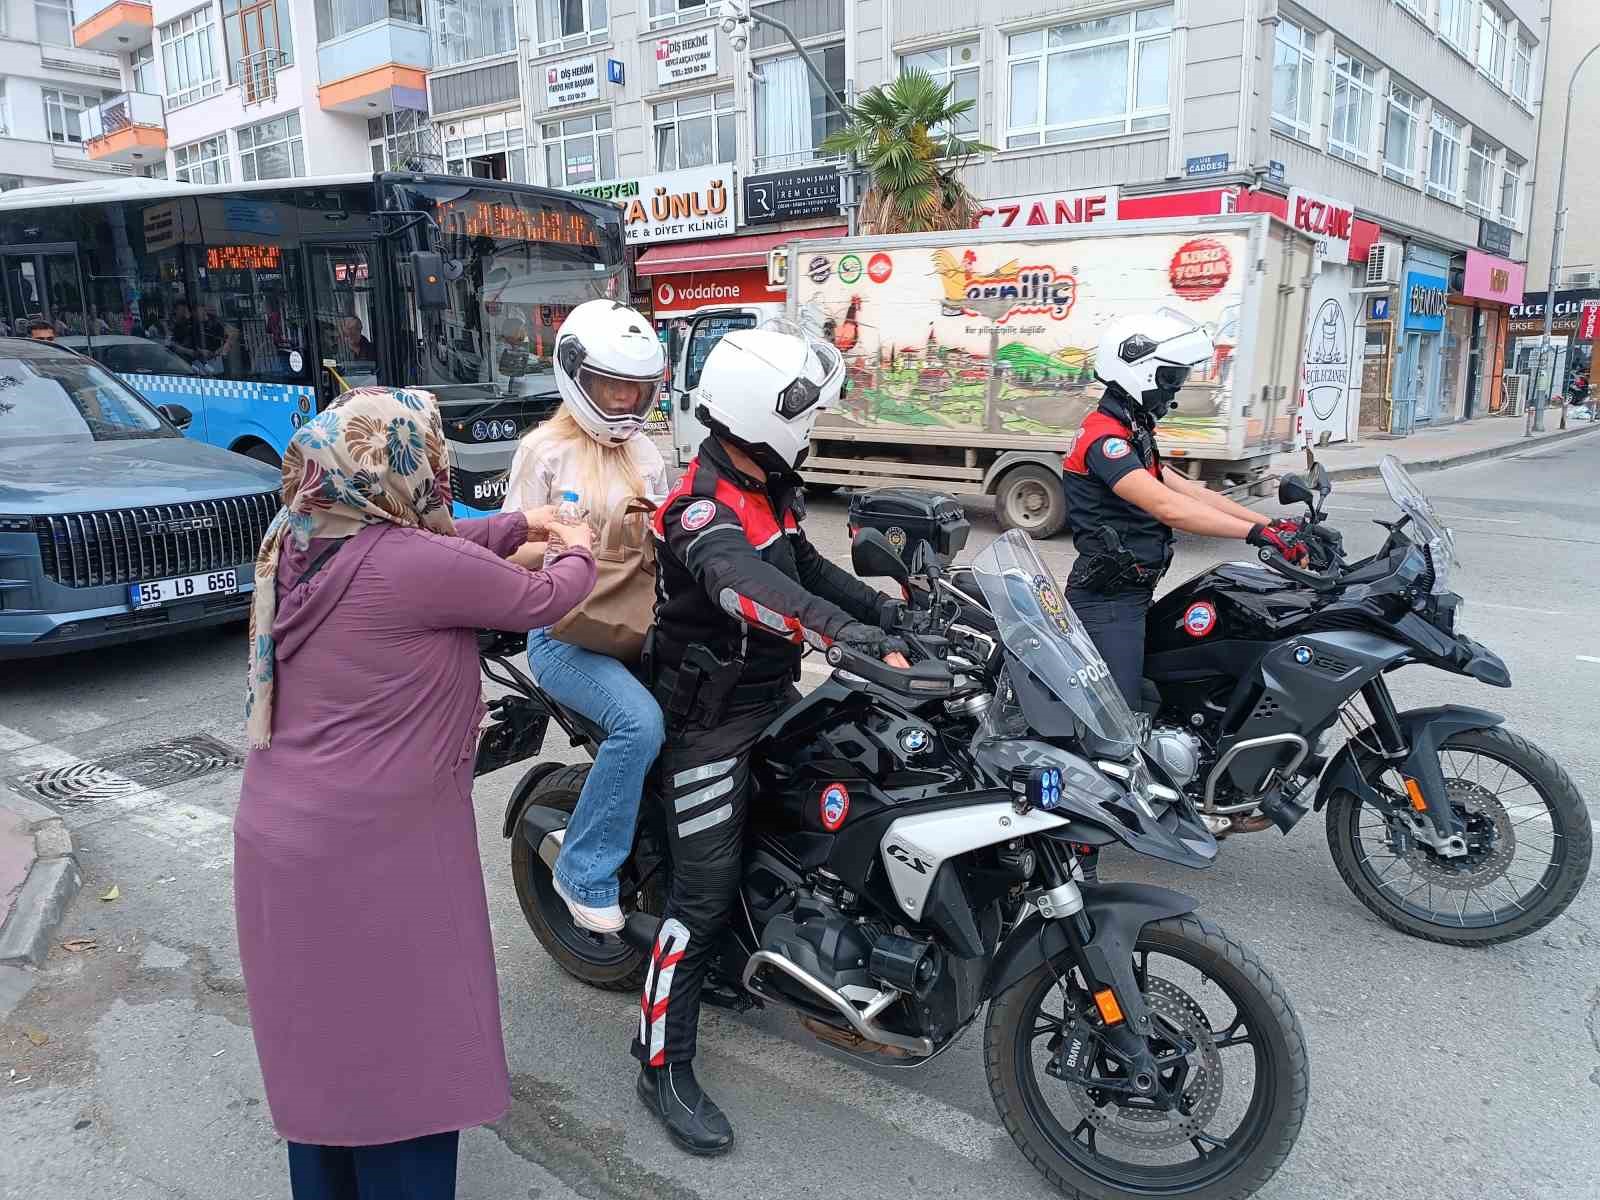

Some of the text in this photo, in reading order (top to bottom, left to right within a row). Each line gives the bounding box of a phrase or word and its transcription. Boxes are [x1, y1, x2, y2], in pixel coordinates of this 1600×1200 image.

[669, 33, 708, 54] DİŞ HEKİMİ
[560, 63, 594, 80] DİŞ HEKİMİ
[652, 179, 728, 221] ÜNLÜ
[806, 183, 836, 198] ÇELİK
[643, 229, 651, 237] &
[655, 223, 683, 236] DİYET
[688, 217, 729, 233] KLİNİĞİ
[1295, 195, 1352, 240] ECZANE
[678, 282, 740, 300] vodafone
[141, 584, 161, 602] 55
[175, 578, 194, 597] LB
[207, 571, 235, 591] 656
[1066, 1038, 1082, 1068] BMW
